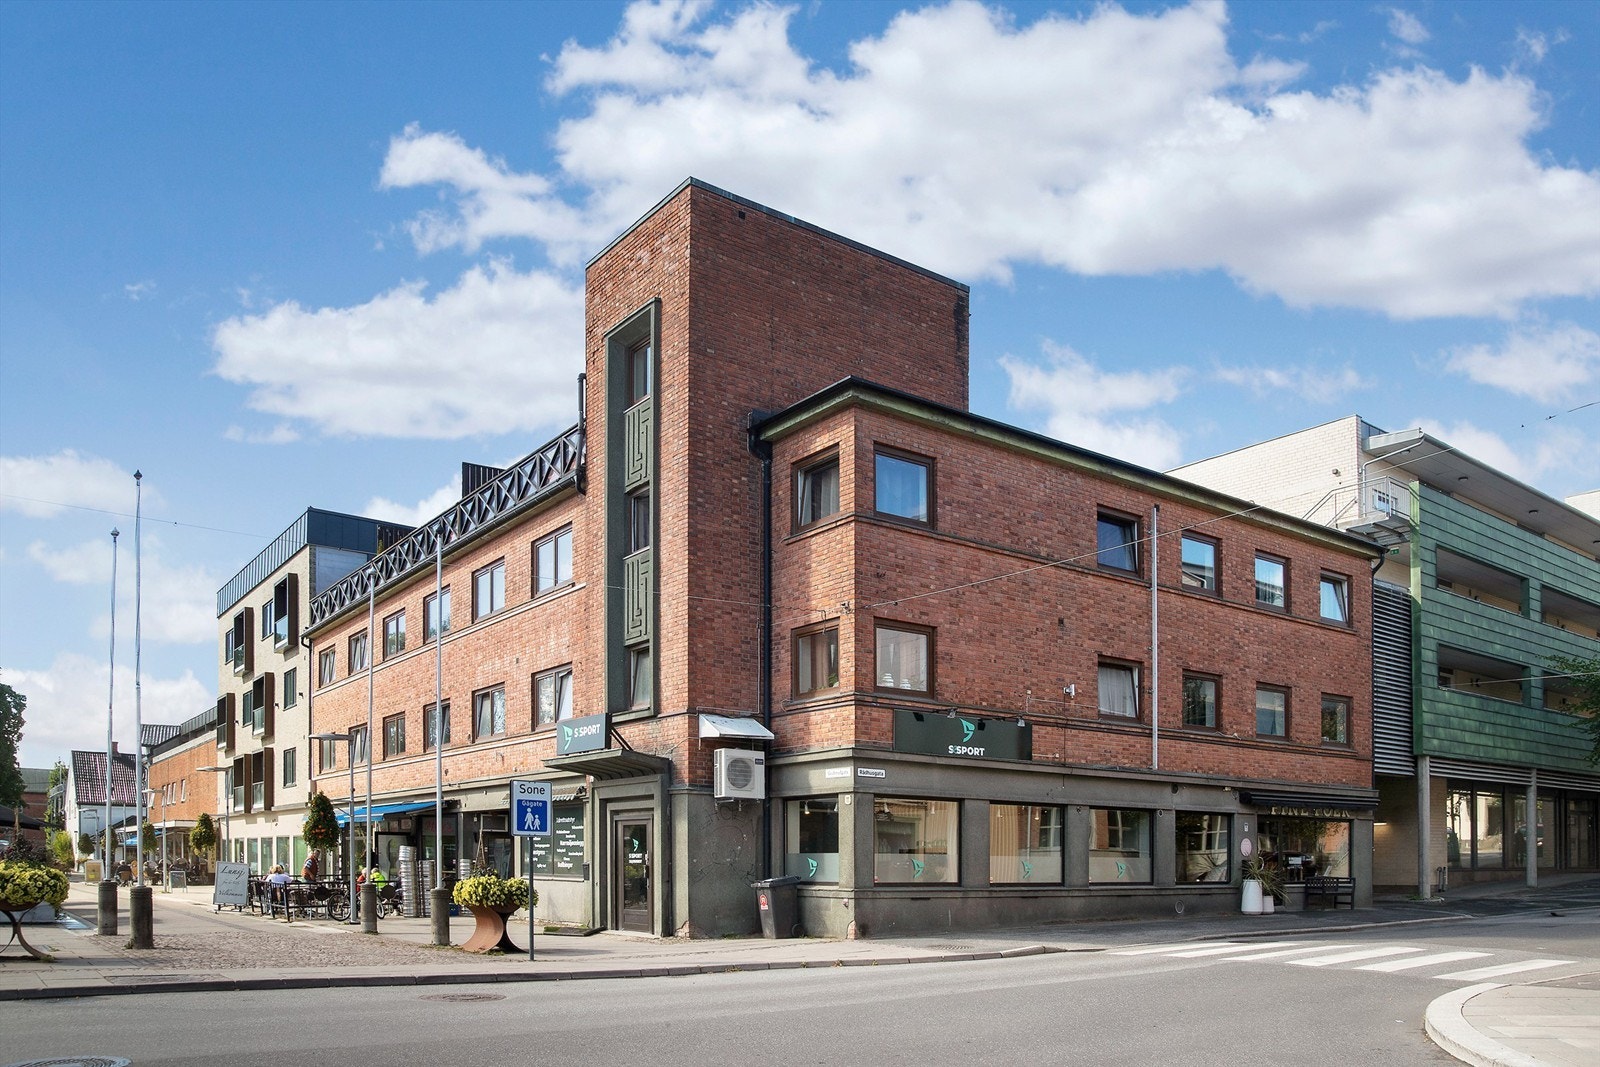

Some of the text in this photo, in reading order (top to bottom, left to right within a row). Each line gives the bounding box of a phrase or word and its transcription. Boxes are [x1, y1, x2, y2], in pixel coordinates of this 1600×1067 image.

[859, 769, 884, 777] Rådhusgata
[519, 784, 546, 795] Sone
[521, 799, 543, 808] Gågate
